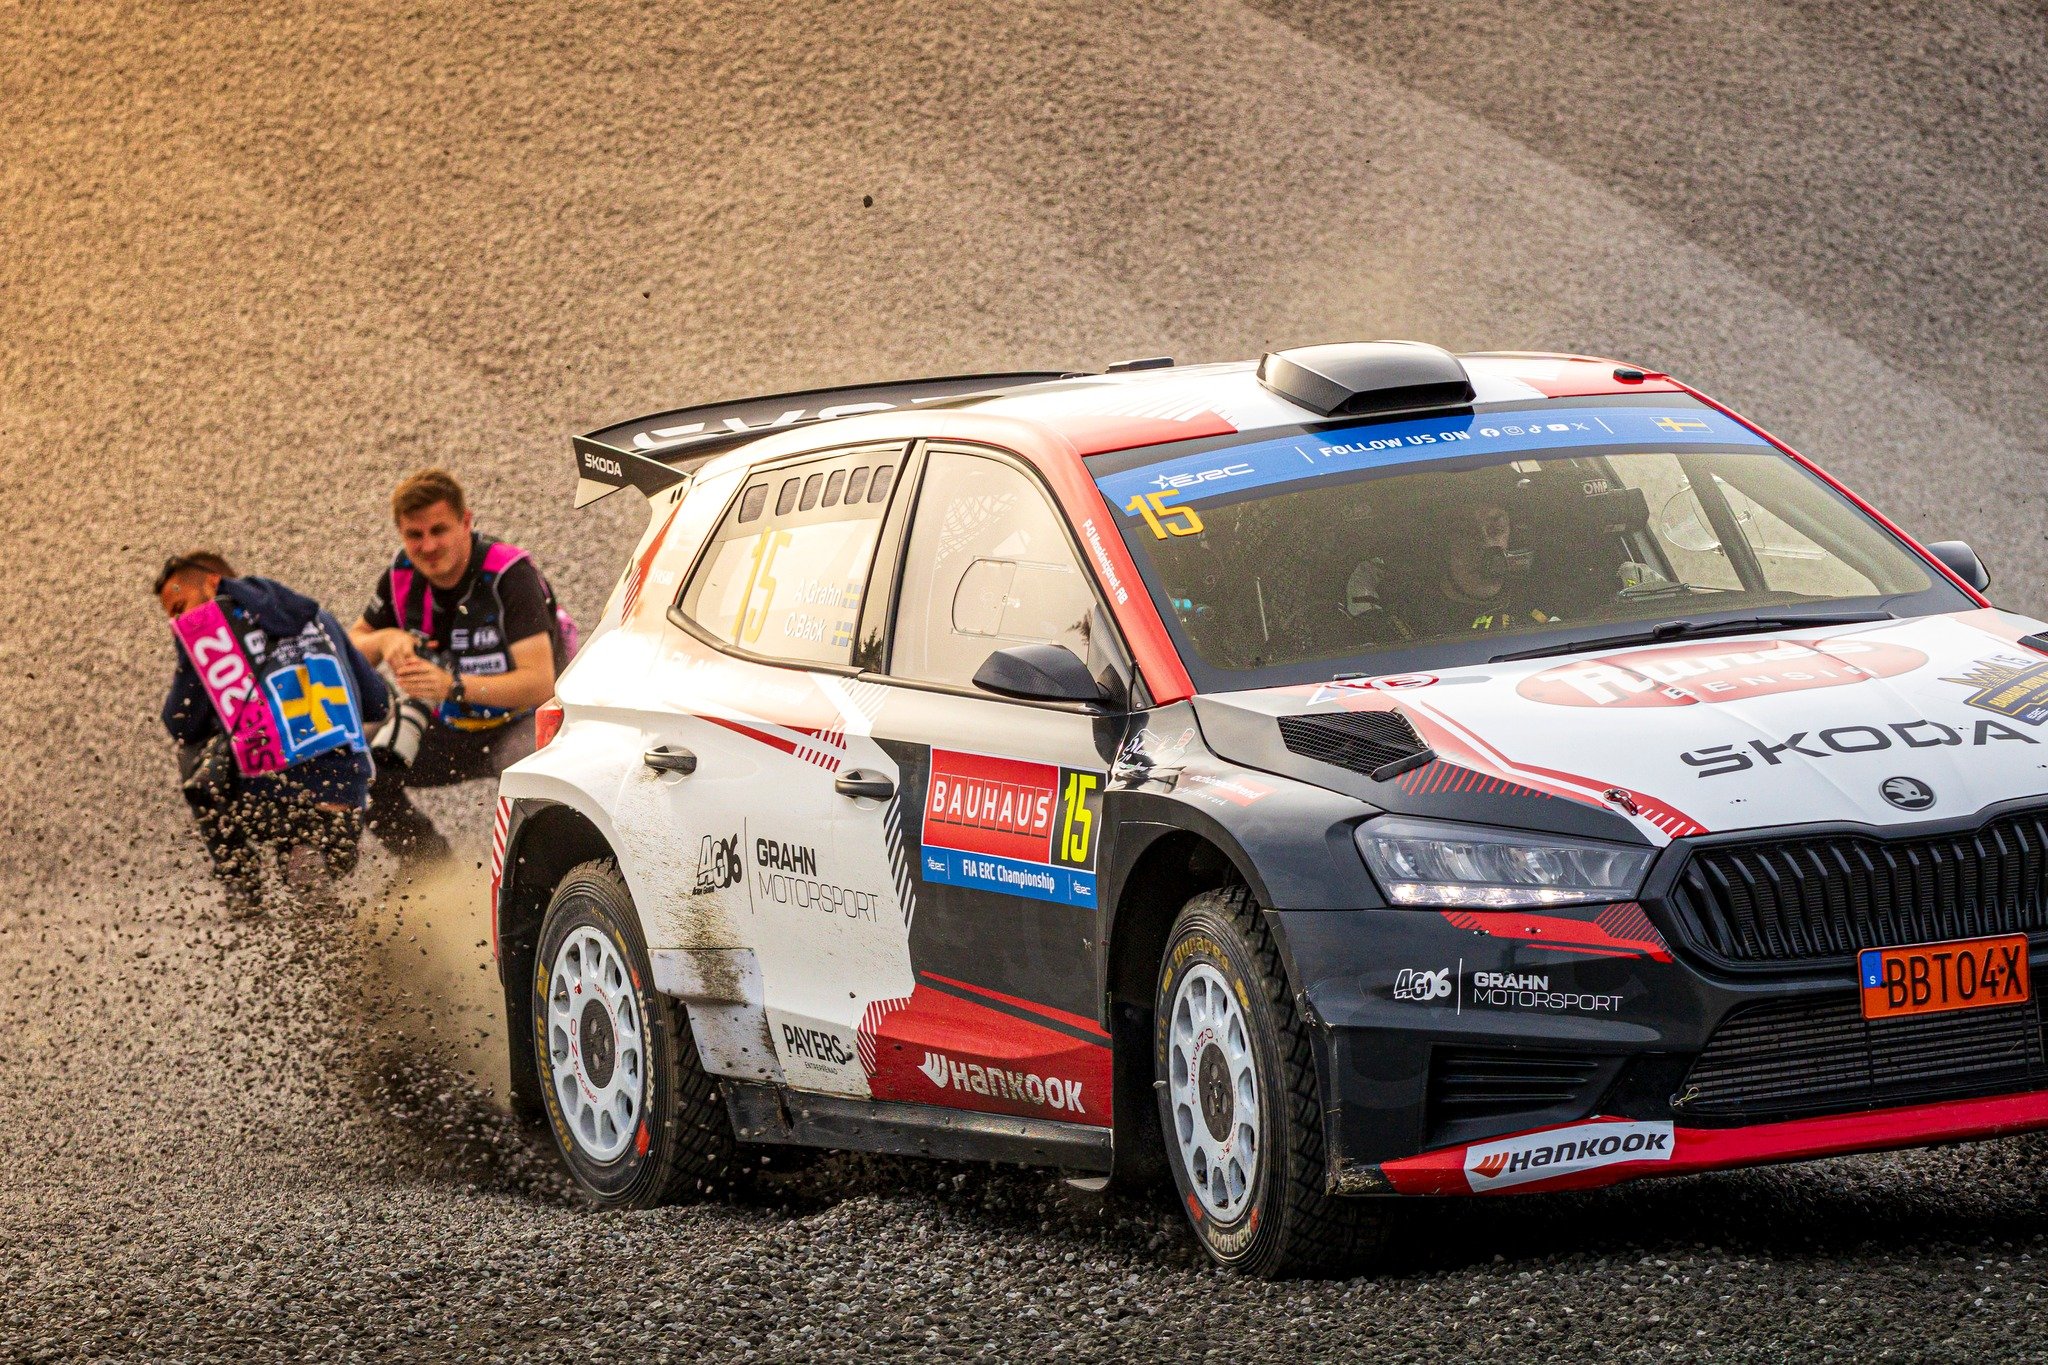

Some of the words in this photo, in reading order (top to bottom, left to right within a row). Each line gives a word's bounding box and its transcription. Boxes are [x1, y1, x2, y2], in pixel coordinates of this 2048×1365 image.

[1319, 437, 1403, 457] FOLLOW
[1406, 434, 1437, 445] US
[1439, 430, 1471, 441] ON
[584, 453, 623, 477] SKODA
[1168, 463, 1255, 487] ERC
[1583, 480, 1608, 495] OMP
[1126, 489, 1205, 540] 15
[731, 526, 793, 644] 15
[1680, 719, 2042, 779] SKODA
[932, 780, 1050, 829] BAUHAUS
[1061, 773, 1097, 863] 15
[756, 837, 817, 877] GRAHN
[963, 859, 978, 877] FIA
[979, 862, 996, 880] ERC
[997, 865, 1055, 893] Championship
[758, 871, 879, 923] MOTORSPORT
[1474, 972, 1549, 991] GRAHN
[1869, 975, 1876, 985] S
[1885, 944, 2023, 1010] BBT04X
[1474, 988, 1624, 1012] MOTORSPORT
[782, 1023, 847, 1066] PAYERS
